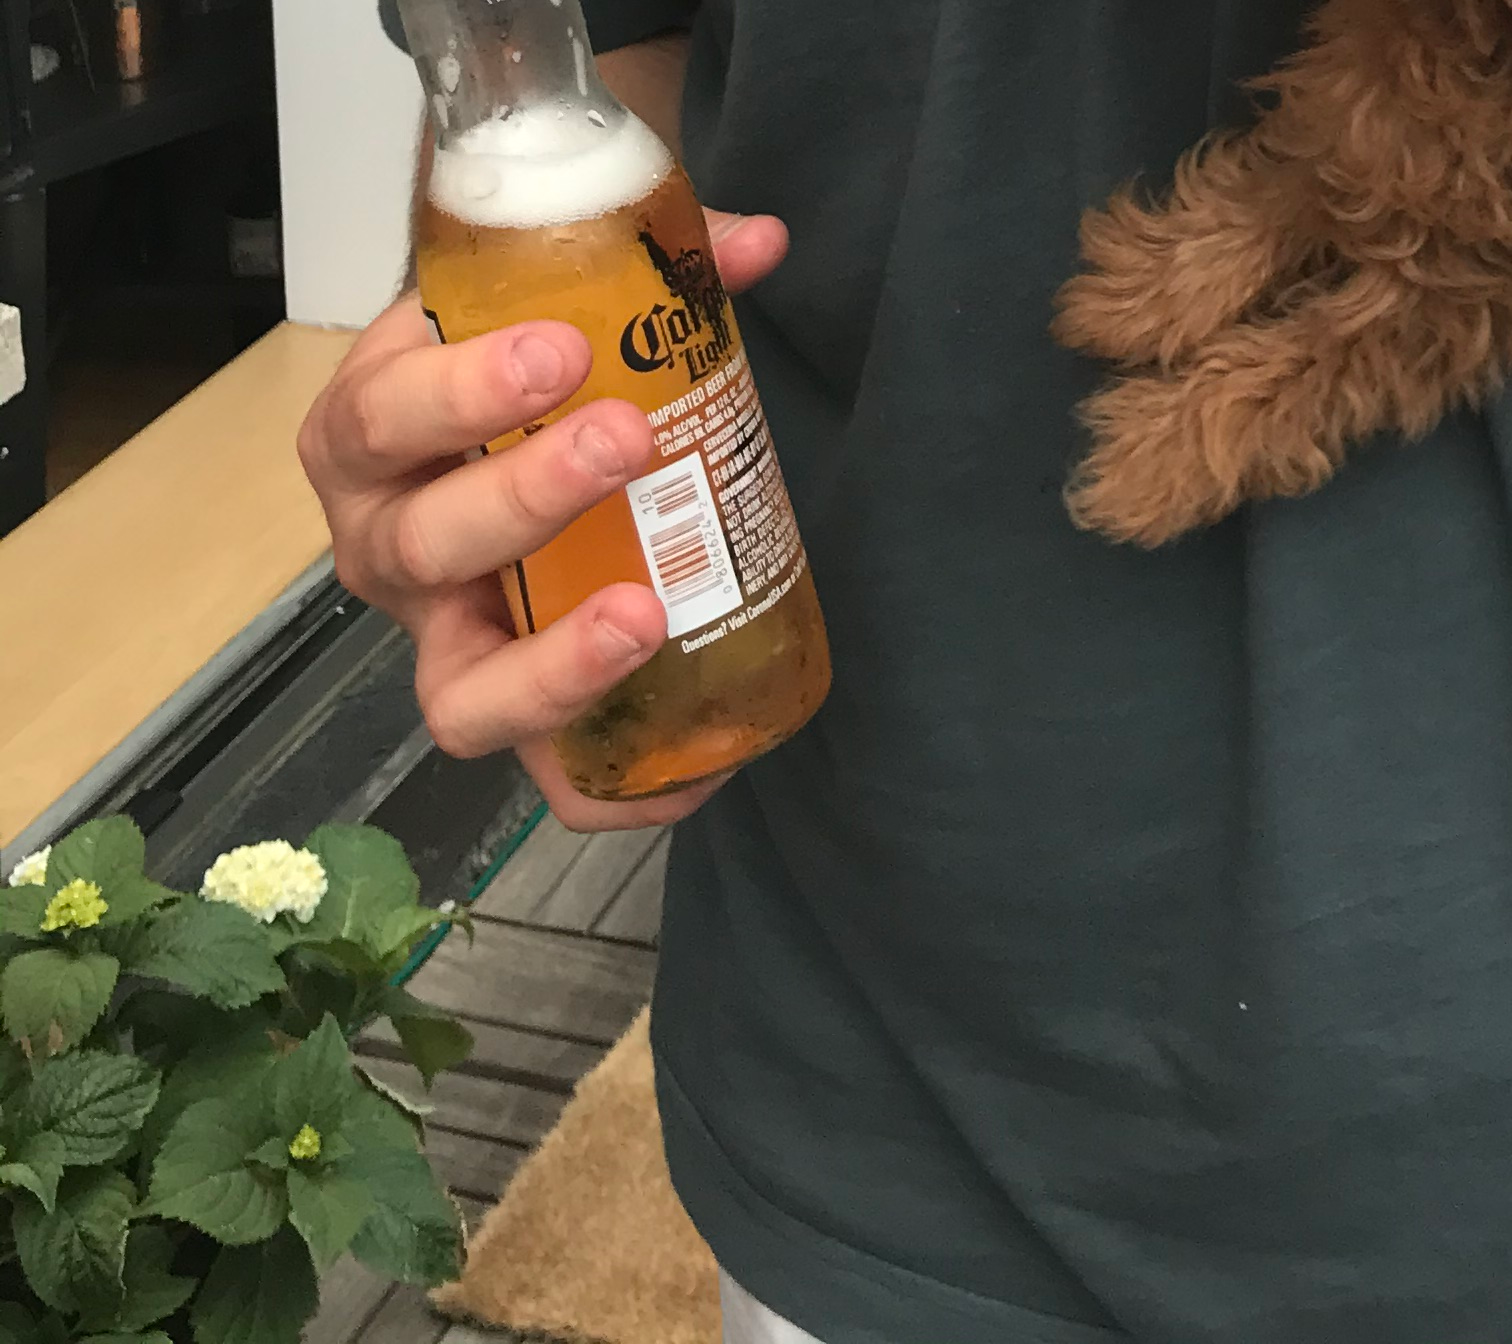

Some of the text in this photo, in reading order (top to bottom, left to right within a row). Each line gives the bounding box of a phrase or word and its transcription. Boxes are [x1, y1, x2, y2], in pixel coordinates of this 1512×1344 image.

[647, 387, 706, 428] IMPORTED
[706, 371, 725, 397] BEER
[637, 491, 656, 516] 10
[721, 501, 737, 516] THE
[726, 513, 741, 530] NOT
[733, 533, 757, 557] BIRTH
[738, 534, 775, 570] ALCOHOLIC
[742, 558, 768, 583] ABILITY
[681, 621, 728, 653] Questions?
[727, 611, 748, 630] Visit
